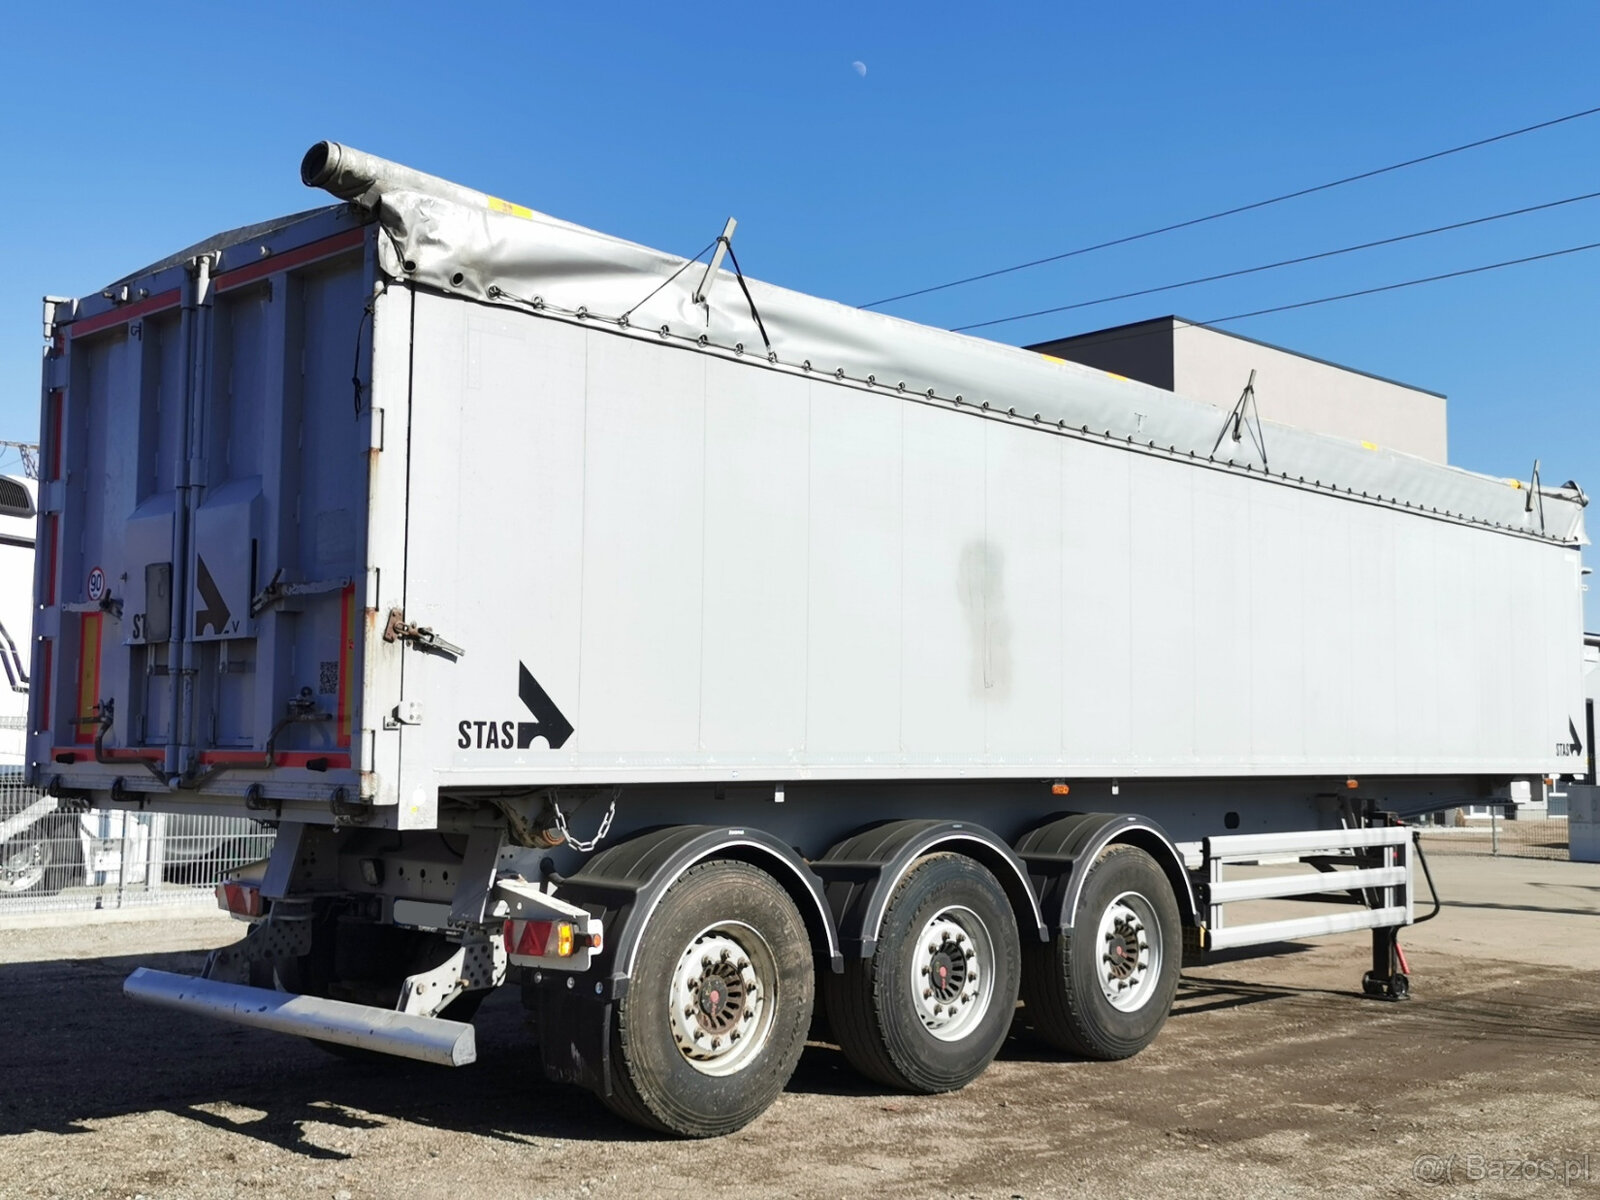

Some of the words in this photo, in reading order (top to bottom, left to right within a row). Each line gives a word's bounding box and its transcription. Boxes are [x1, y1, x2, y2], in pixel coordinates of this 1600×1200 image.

[90, 574, 102, 592] 90
[132, 613, 147, 639] ST
[458, 720, 515, 749] STAS
[1556, 743, 1570, 756] STAS
